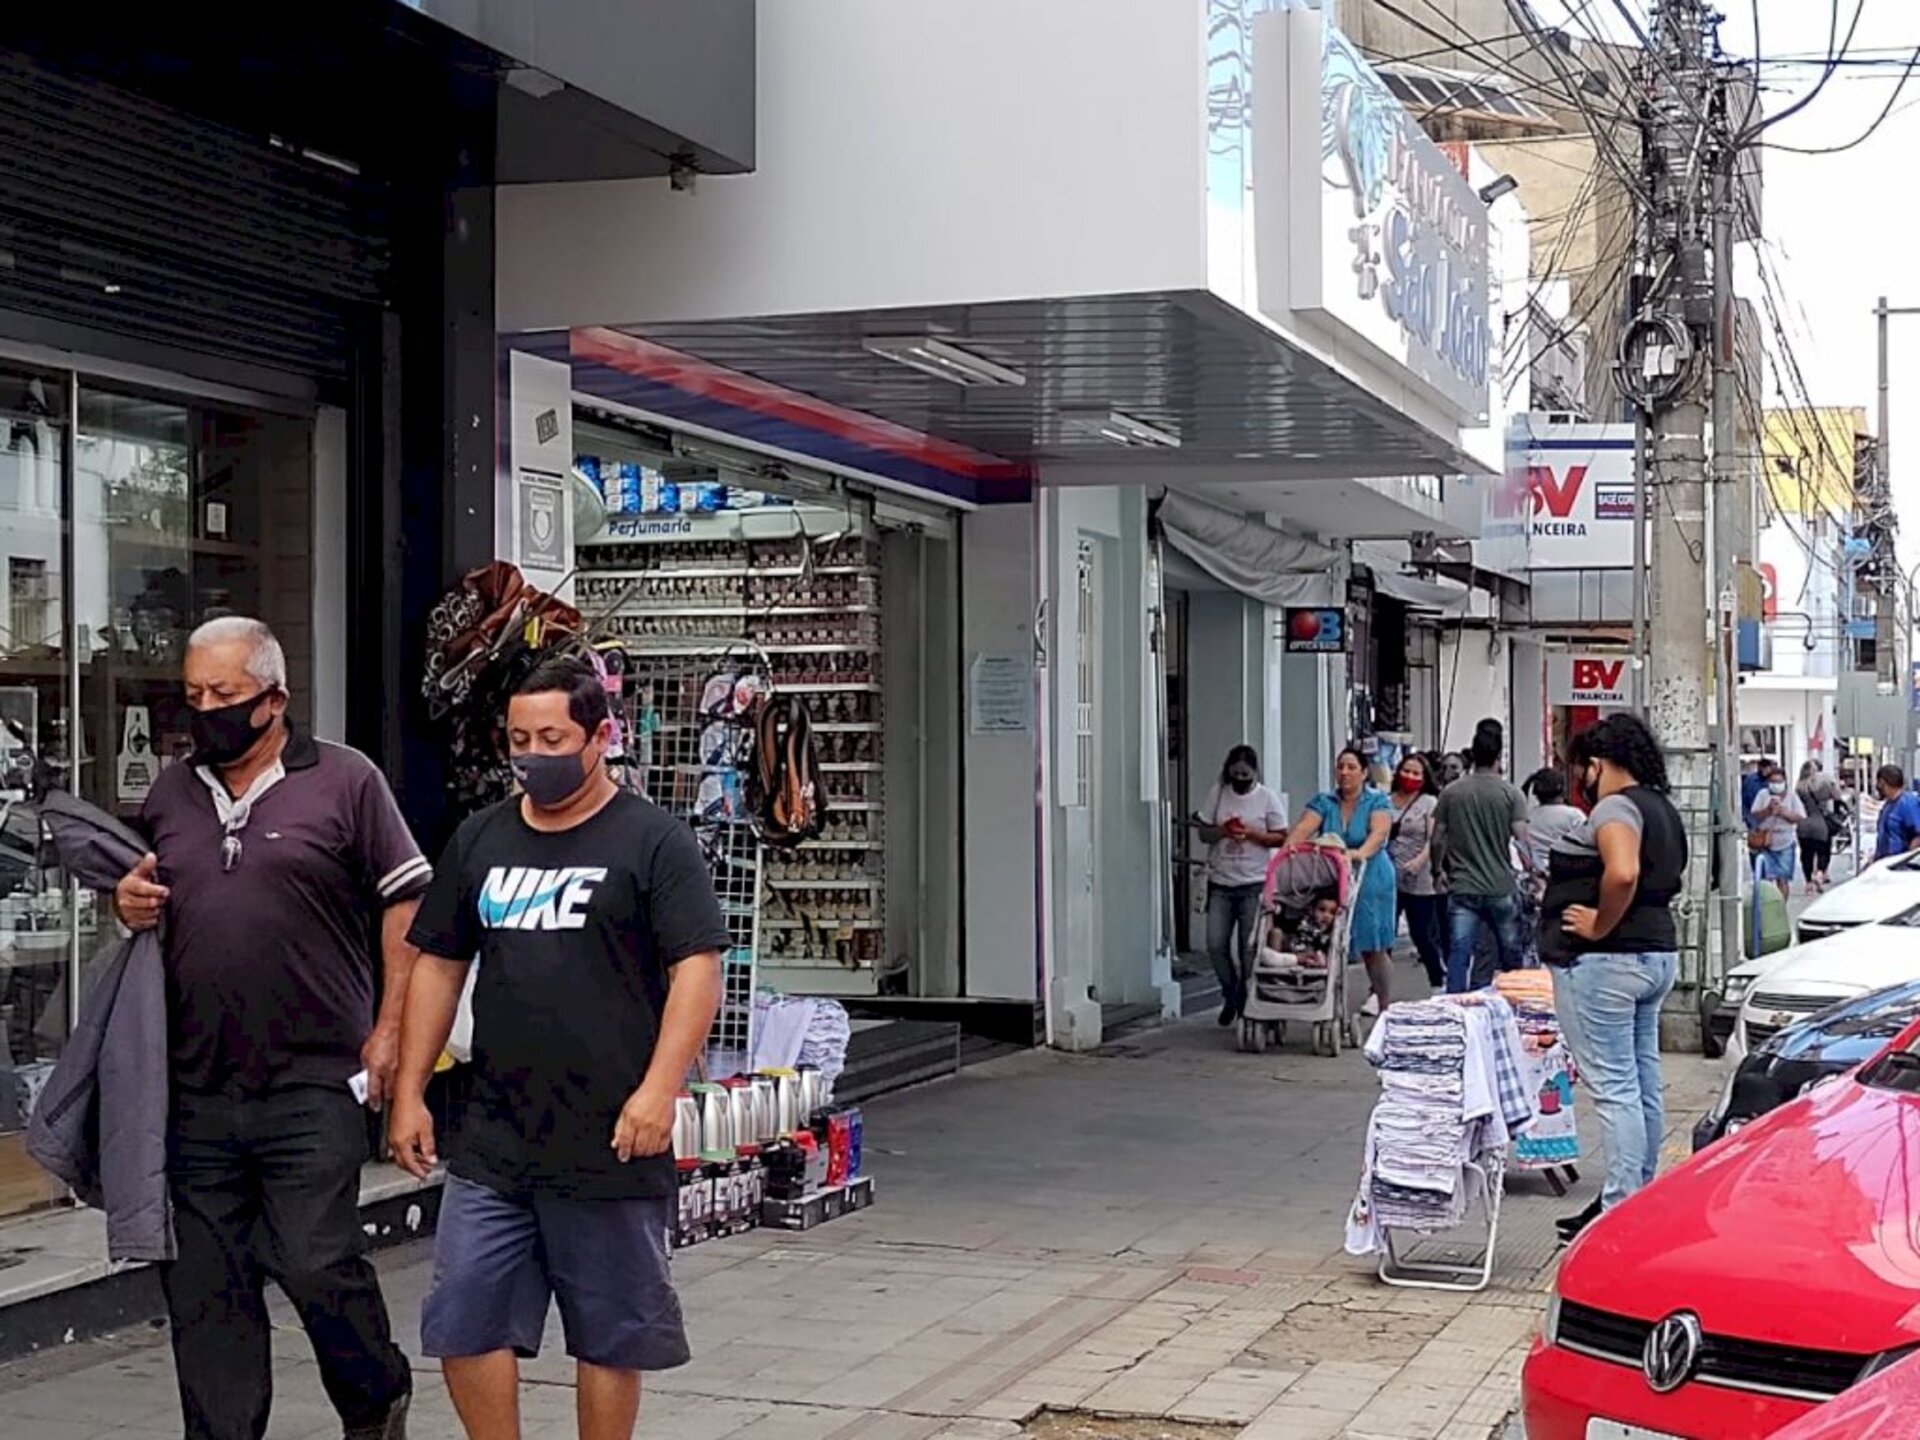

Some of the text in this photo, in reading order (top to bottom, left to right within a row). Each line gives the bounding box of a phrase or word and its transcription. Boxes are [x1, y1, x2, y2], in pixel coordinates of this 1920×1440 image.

[608, 519, 692, 537] Perfumaria
[1573, 659, 1625, 690] BV
[477, 867, 608, 931] NIKE
